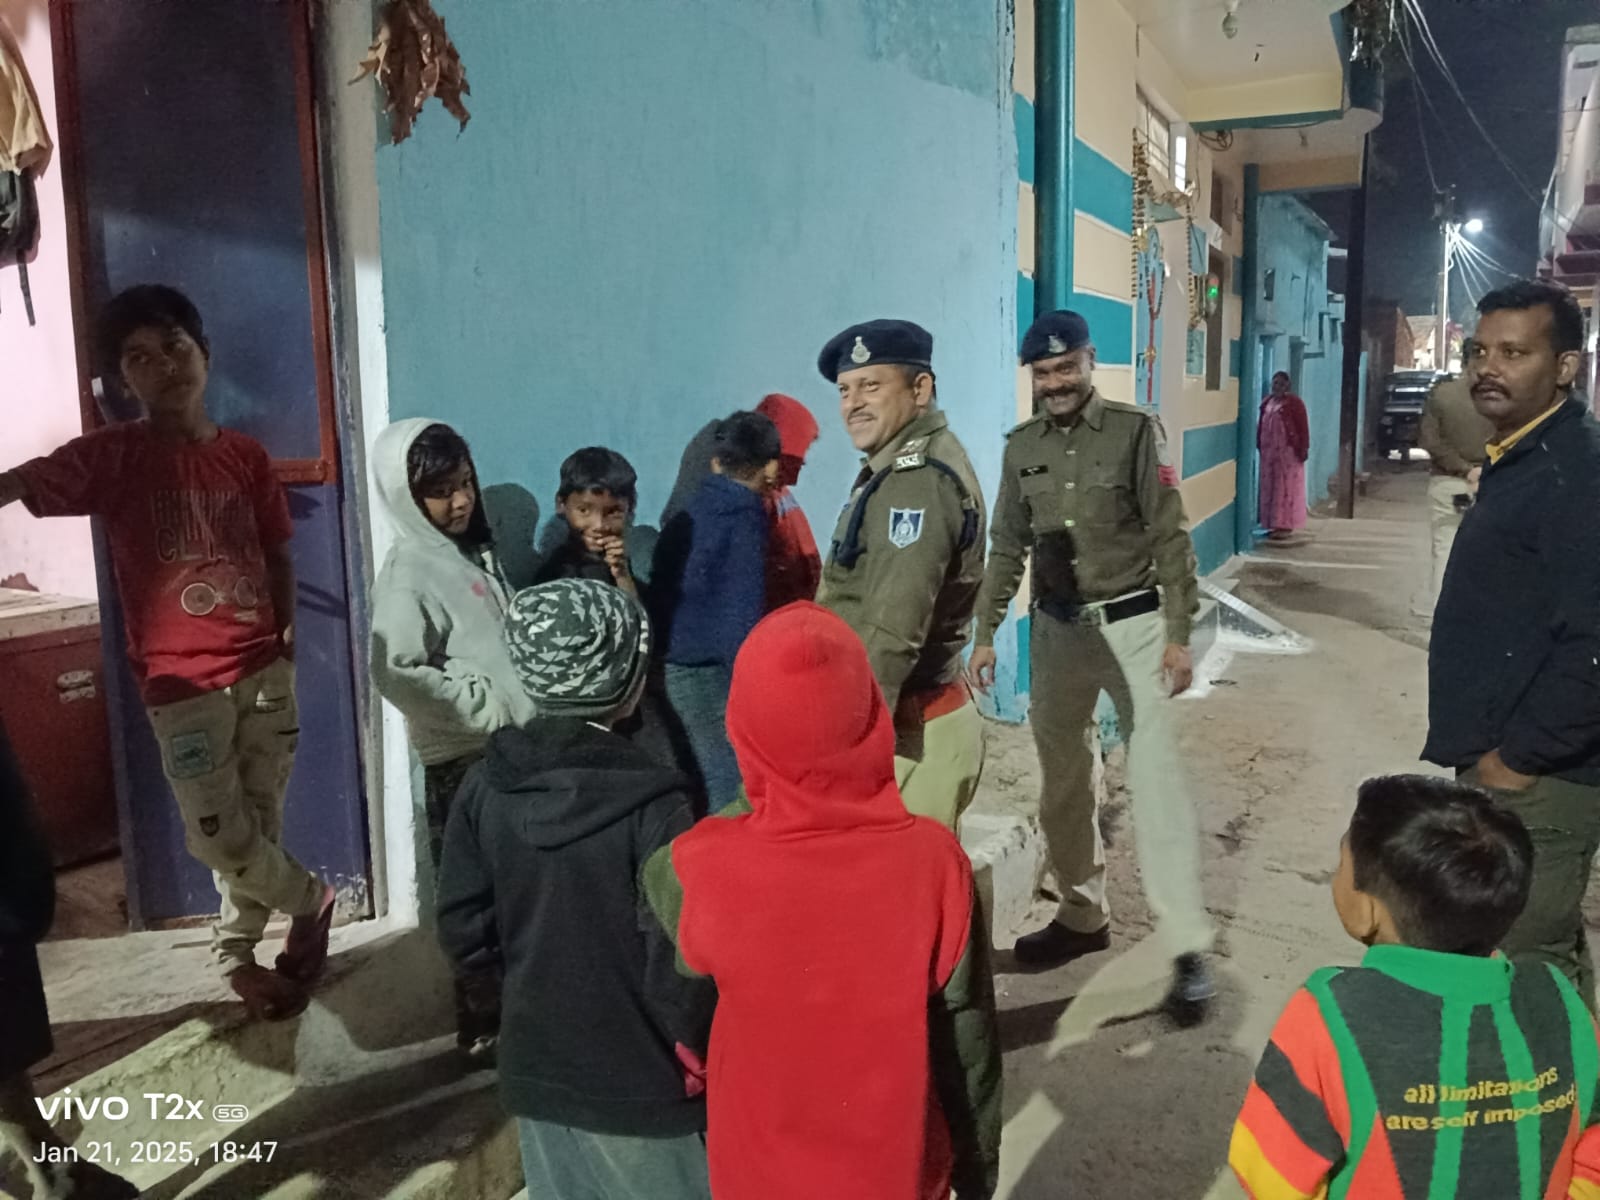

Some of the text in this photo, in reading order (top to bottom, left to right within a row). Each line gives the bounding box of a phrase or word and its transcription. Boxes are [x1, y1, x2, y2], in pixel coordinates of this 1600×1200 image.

[1385, 1083, 1576, 1130] are self imposed
